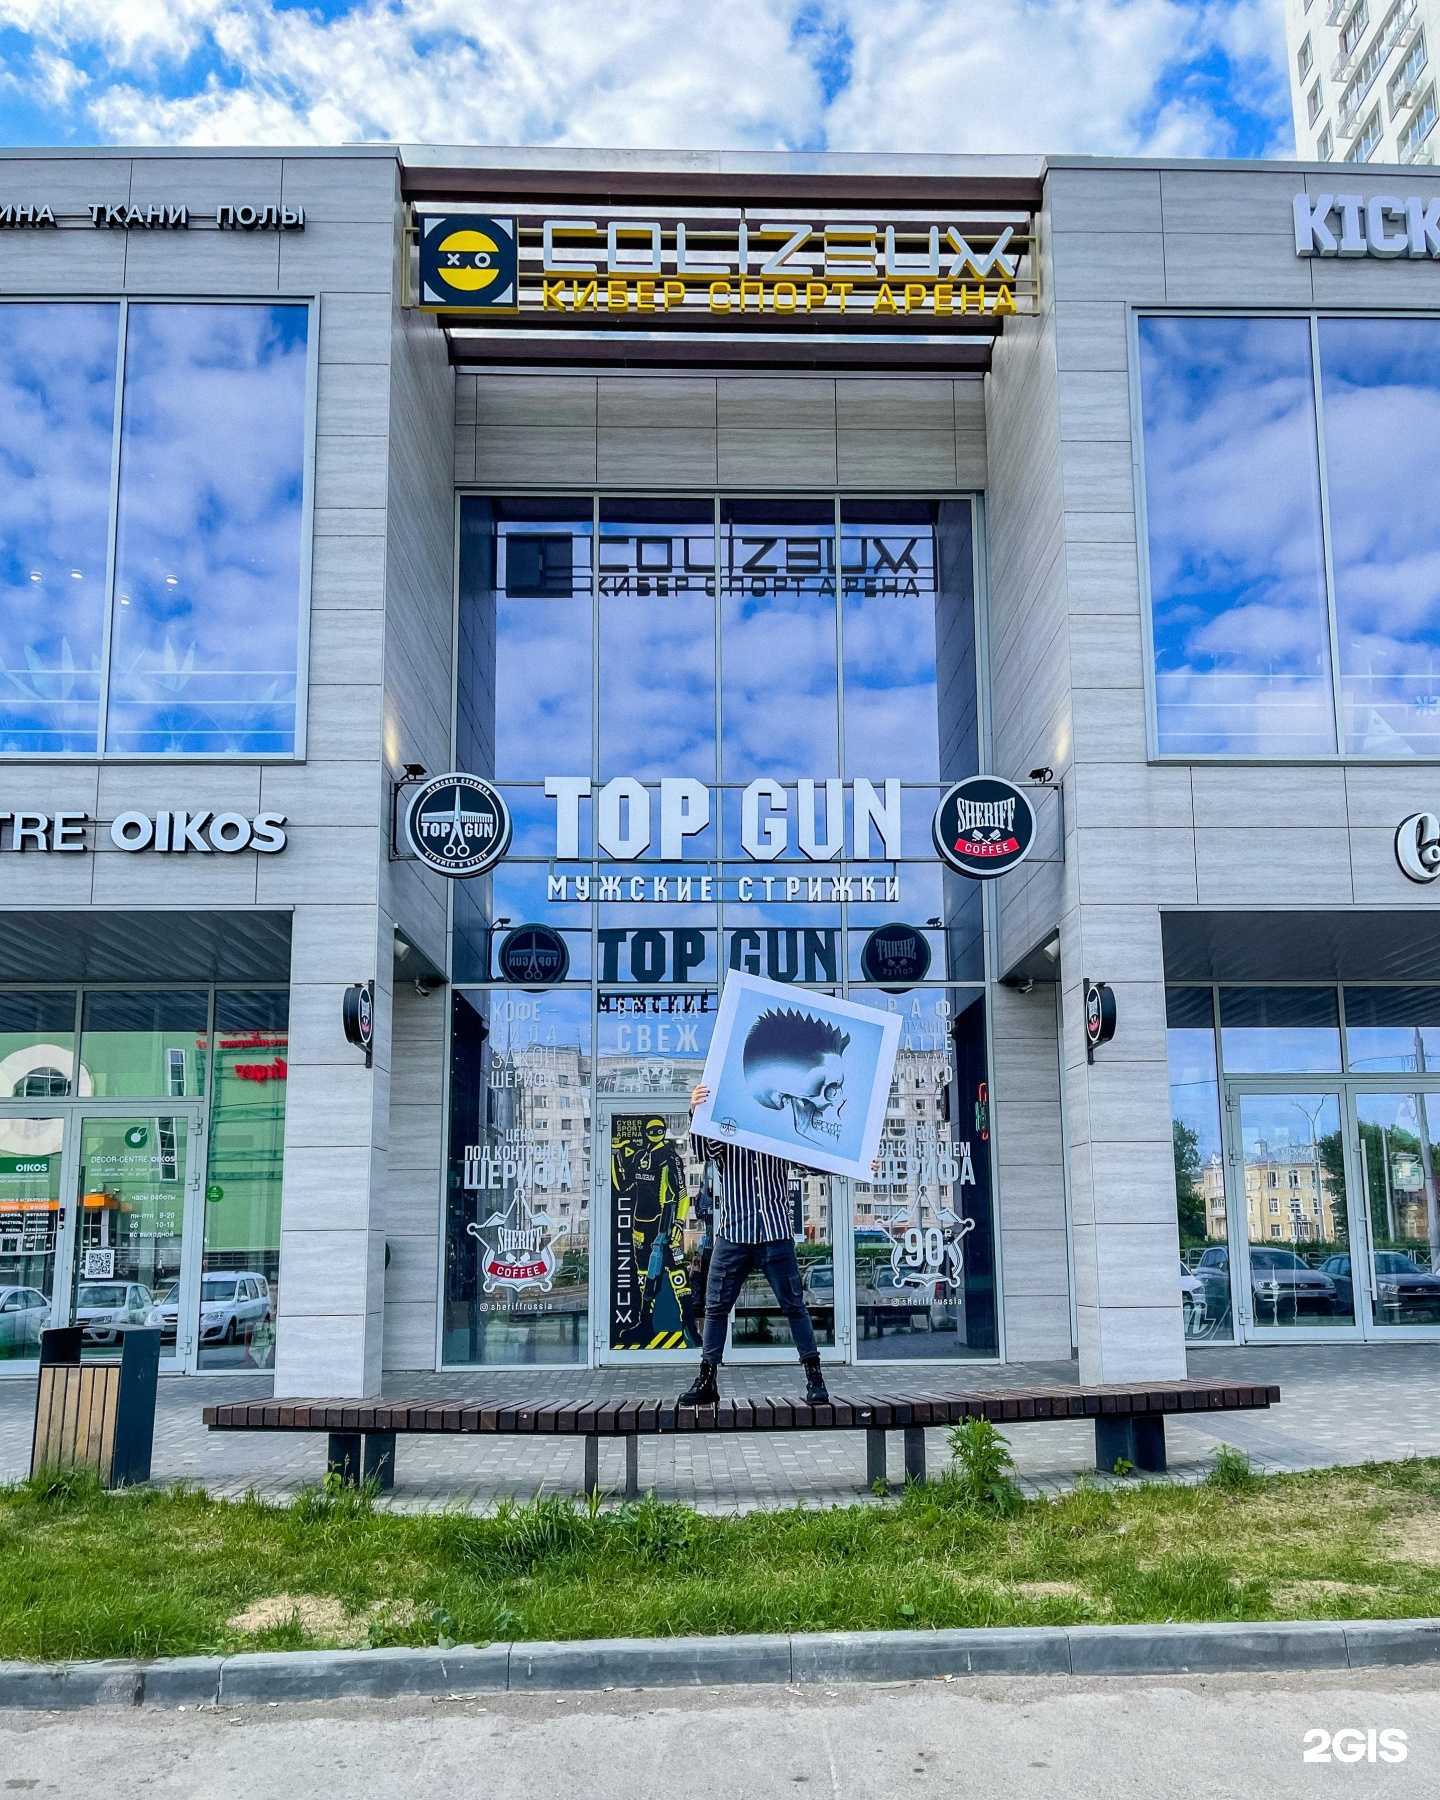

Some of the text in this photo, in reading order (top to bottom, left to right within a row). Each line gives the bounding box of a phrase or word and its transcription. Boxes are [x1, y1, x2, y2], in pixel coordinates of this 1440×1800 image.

[88, 204, 188, 226] ТКАНИ
[216, 205, 305, 228] ПОЛЫ
[1293, 193, 1440, 257] KICK
[543, 220, 1015, 281] COLIZEUM
[543, 280, 1017, 316] КИБЕР СПОРТ АРЕНА
[544, 777, 901, 861] TOP GUN
[956, 796, 1016, 834] SHERIFF
[111, 811, 287, 852] OIKOS
[421, 822, 494, 838] TOP GUN
[964, 842, 1010, 855] COFFEE
[547, 874, 900, 902] МУЖСКИЕ СТРИЖКИ
[597, 929, 706, 983] TOP
[492, 1000, 541, 1021] КОФЕ
[617, 1024, 699, 1052] СВЕЖ
[505, 1128, 535, 1142] ЦЕНА
[15, 1163, 48, 1172] OIKOS
[464, 1145, 491, 1163] ПОД
[463, 1160, 572, 1190] ШЕРИФА
[497, 1226, 543, 1254] SHERIFF
[904, 1227, 944, 1267] 90
[496, 1266, 541, 1278] COFFEE
